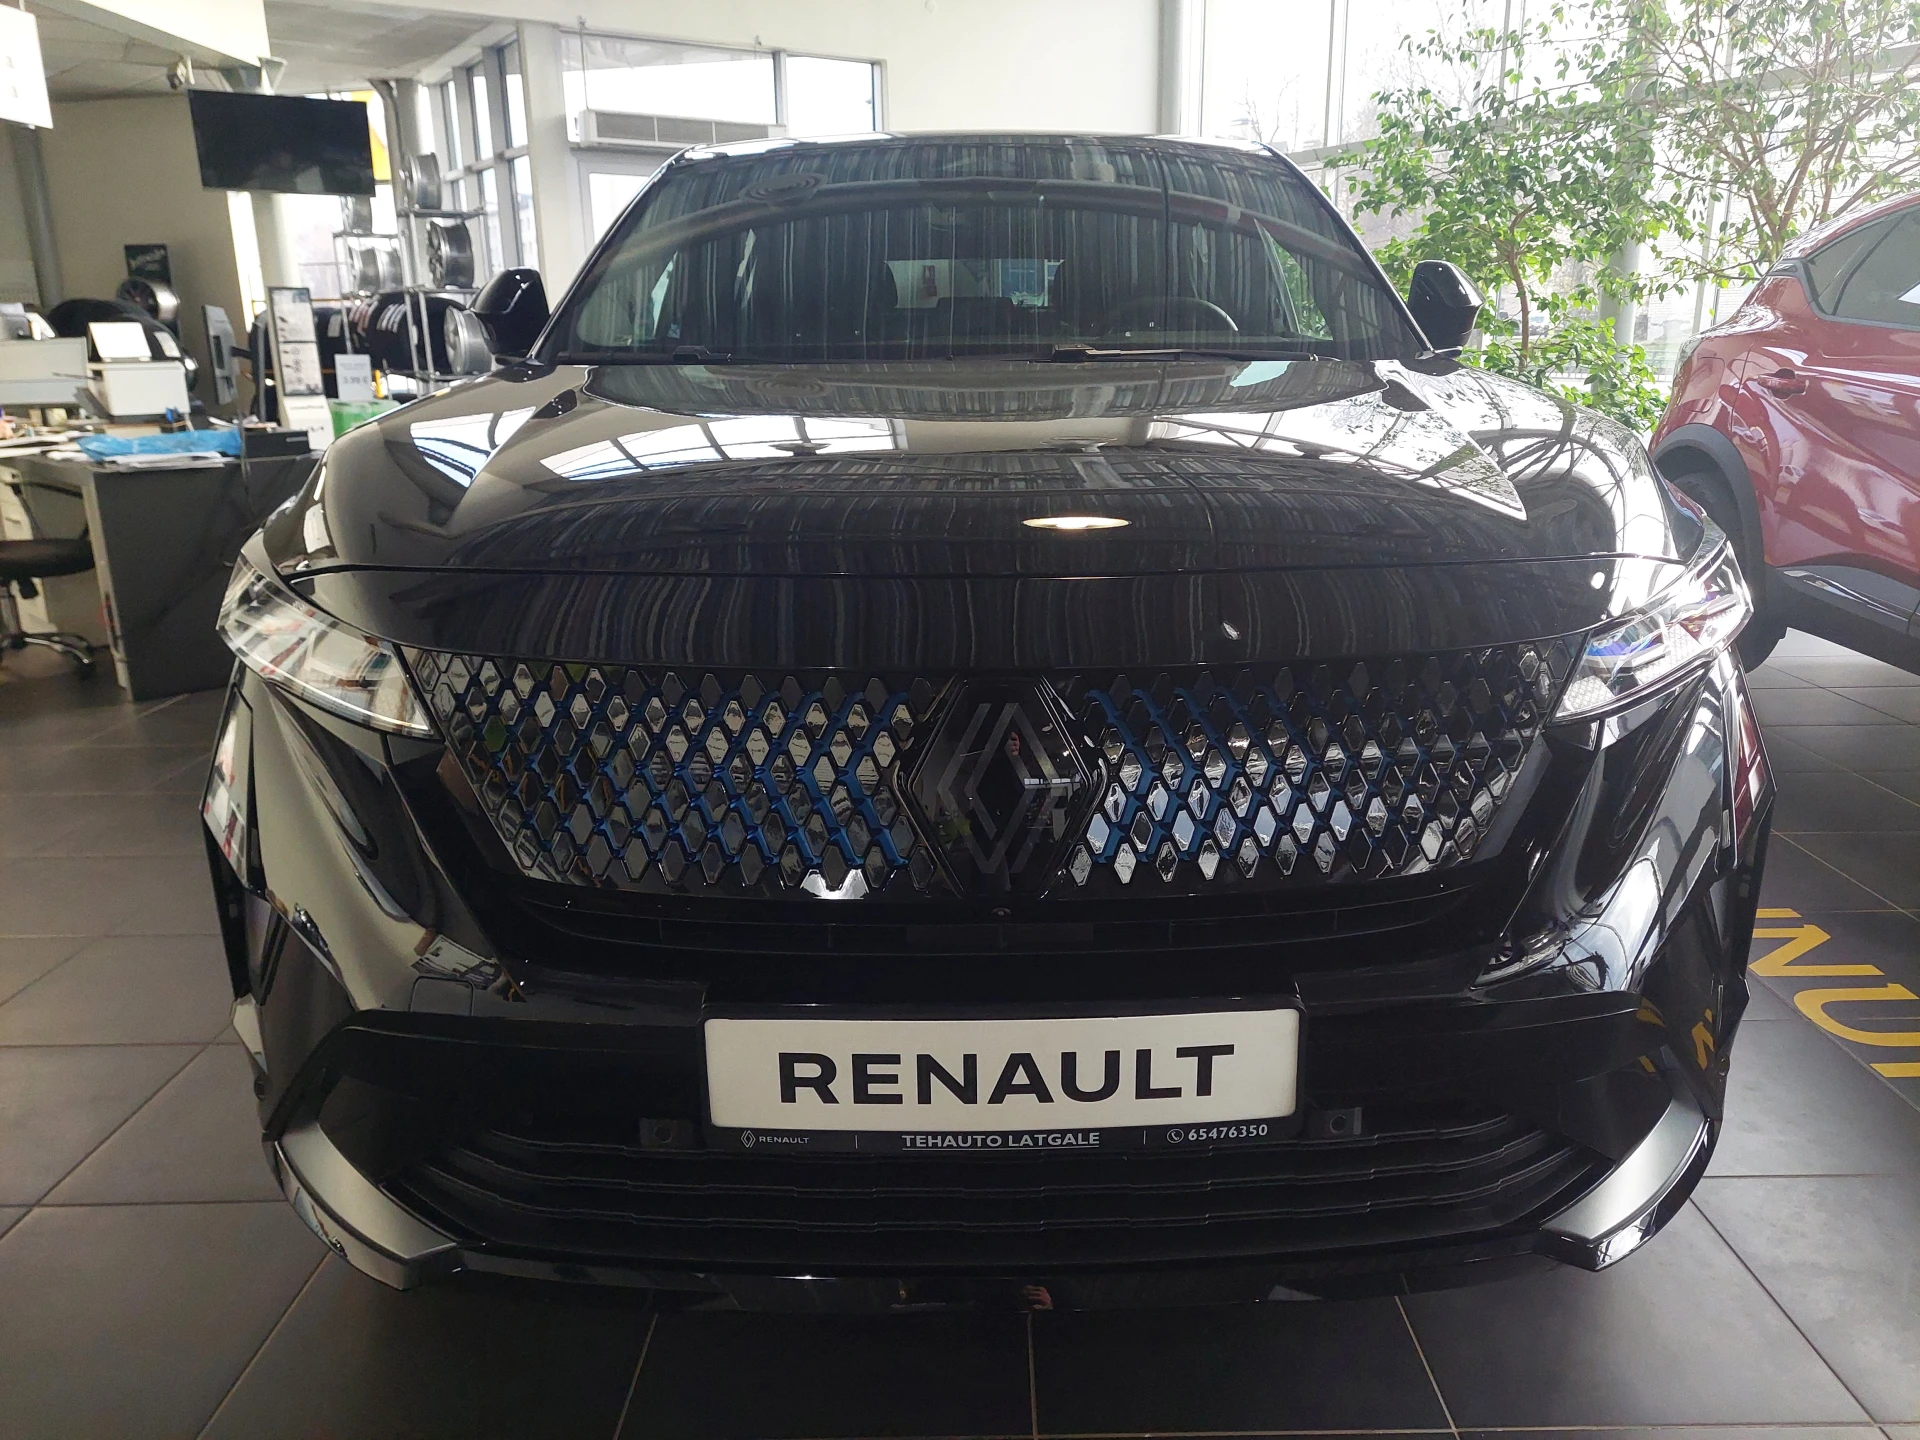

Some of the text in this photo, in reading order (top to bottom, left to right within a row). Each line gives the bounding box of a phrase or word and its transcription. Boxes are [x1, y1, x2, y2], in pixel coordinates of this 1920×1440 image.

[778, 1044, 1235, 1105] RENAULT
[758, 1136, 810, 1144] RENAULT
[902, 1132, 1100, 1148] TEHAUTO LATGALE
[1188, 1124, 1268, 1141] 65476350
